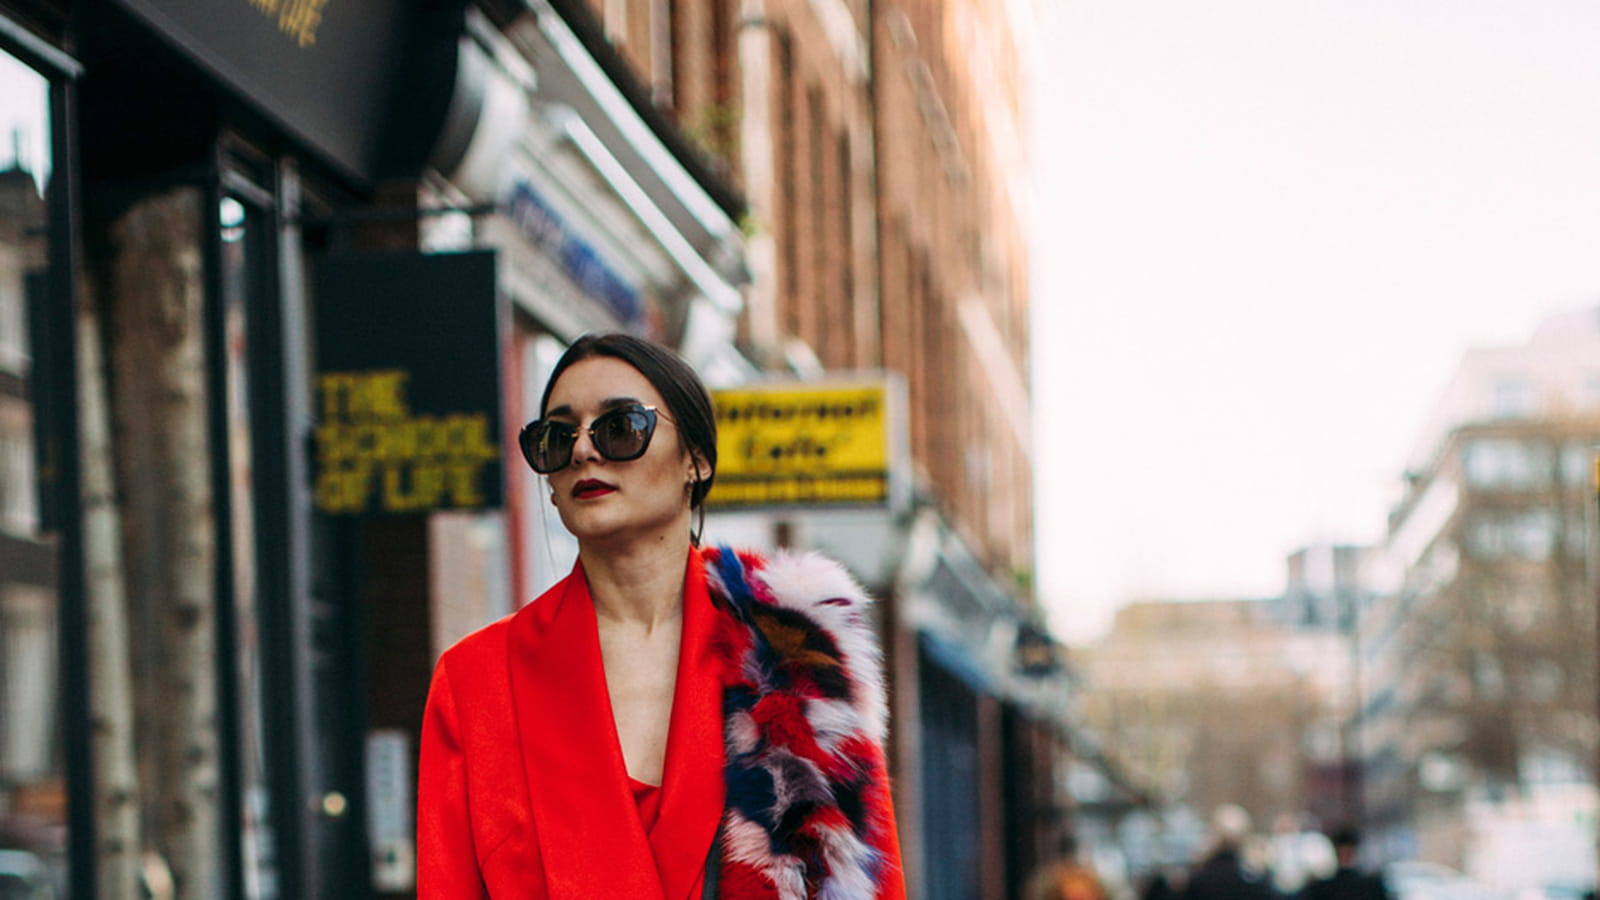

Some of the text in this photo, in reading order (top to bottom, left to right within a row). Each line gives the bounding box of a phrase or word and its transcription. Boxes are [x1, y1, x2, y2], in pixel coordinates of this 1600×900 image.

[321, 372, 408, 421] THE
[317, 415, 496, 461] SCHOOL
[317, 462, 482, 513] OF LIFE
